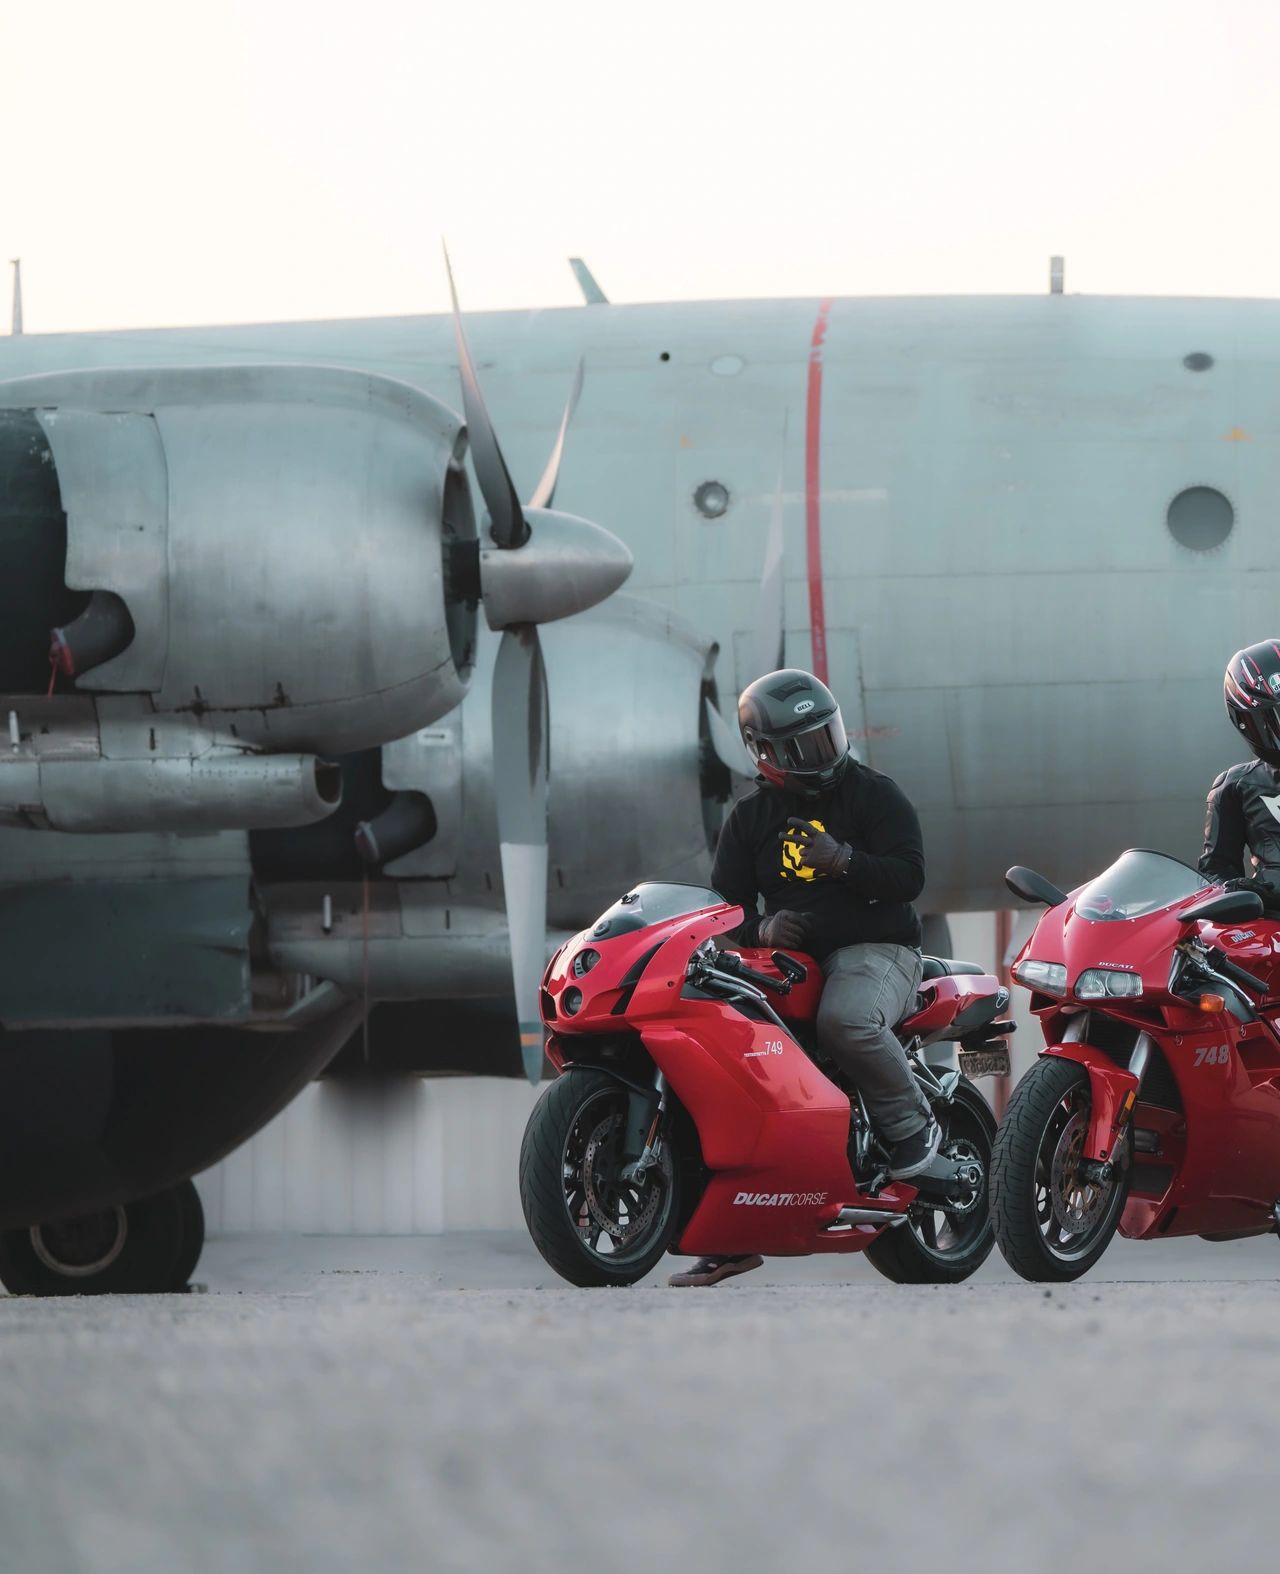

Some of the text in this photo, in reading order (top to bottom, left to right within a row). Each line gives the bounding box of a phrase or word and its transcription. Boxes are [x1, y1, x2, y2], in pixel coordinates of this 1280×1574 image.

[797, 702, 812, 712] BELL
[1230, 930, 1257, 943] DUCATI
[1098, 961, 1134, 969] DUCATI
[765, 1040, 783, 1055] 749
[1193, 1044, 1229, 1067] 748
